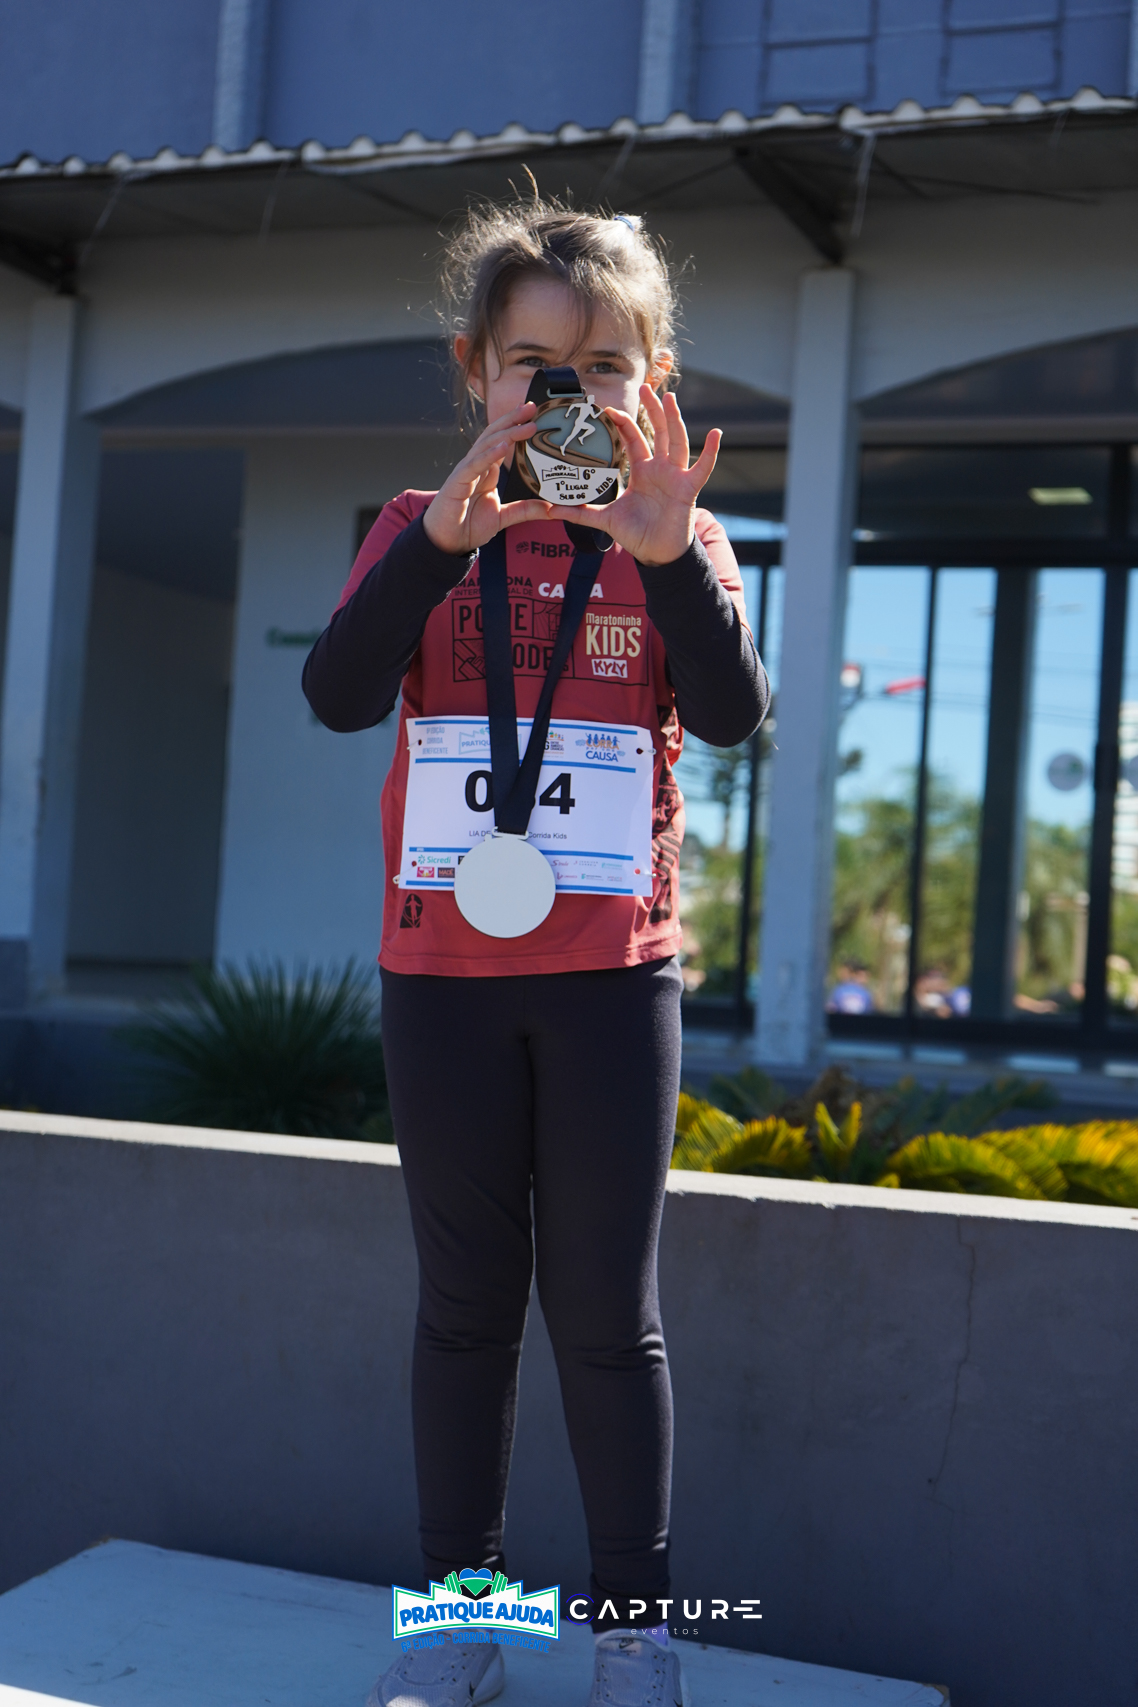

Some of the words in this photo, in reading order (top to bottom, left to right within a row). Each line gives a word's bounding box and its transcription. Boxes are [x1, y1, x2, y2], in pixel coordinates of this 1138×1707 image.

[595, 476, 614, 495] KIDS
[455, 576, 533, 588] MAONA
[538, 581, 604, 599] CAA
[454, 588, 521, 596] INTERNAL
[523, 588, 533, 596] DE
[459, 603, 528, 634] POE
[585, 612, 642, 627] Maratoninha
[586, 624, 642, 658] KIDS
[512, 643, 555, 671] ODE
[593, 659, 626, 677] KYLY
[462, 739, 491, 747] PRATIQU
[585, 750, 619, 763] CAUSA
[464, 769, 576, 815] 04
[528, 831, 551, 839] Corrida
[427, 855, 452, 864] Sicredi
